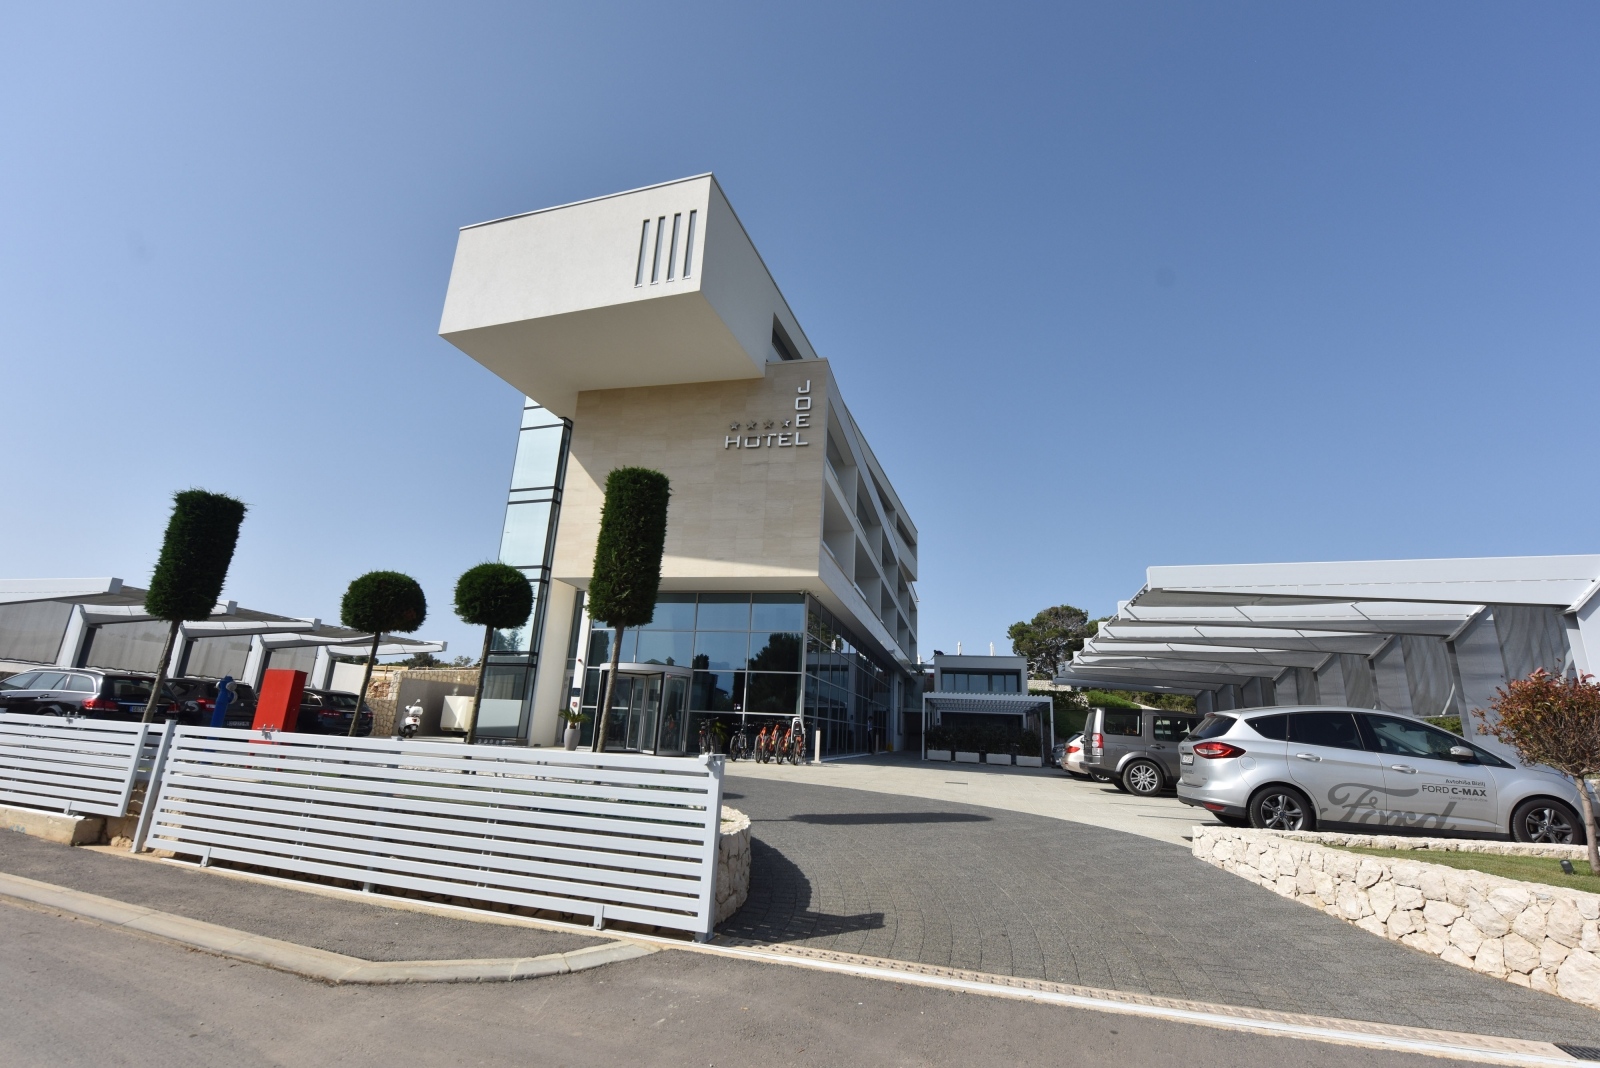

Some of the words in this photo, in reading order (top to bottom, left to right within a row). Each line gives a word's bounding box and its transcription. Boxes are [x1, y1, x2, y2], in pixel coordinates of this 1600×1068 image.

[794, 379, 811, 446] JOEL
[724, 431, 809, 450] HOTEL
[1321, 782, 1457, 831] Ford
[1421, 784, 1450, 794] FORD
[1451, 787, 1487, 797] C-MAX
